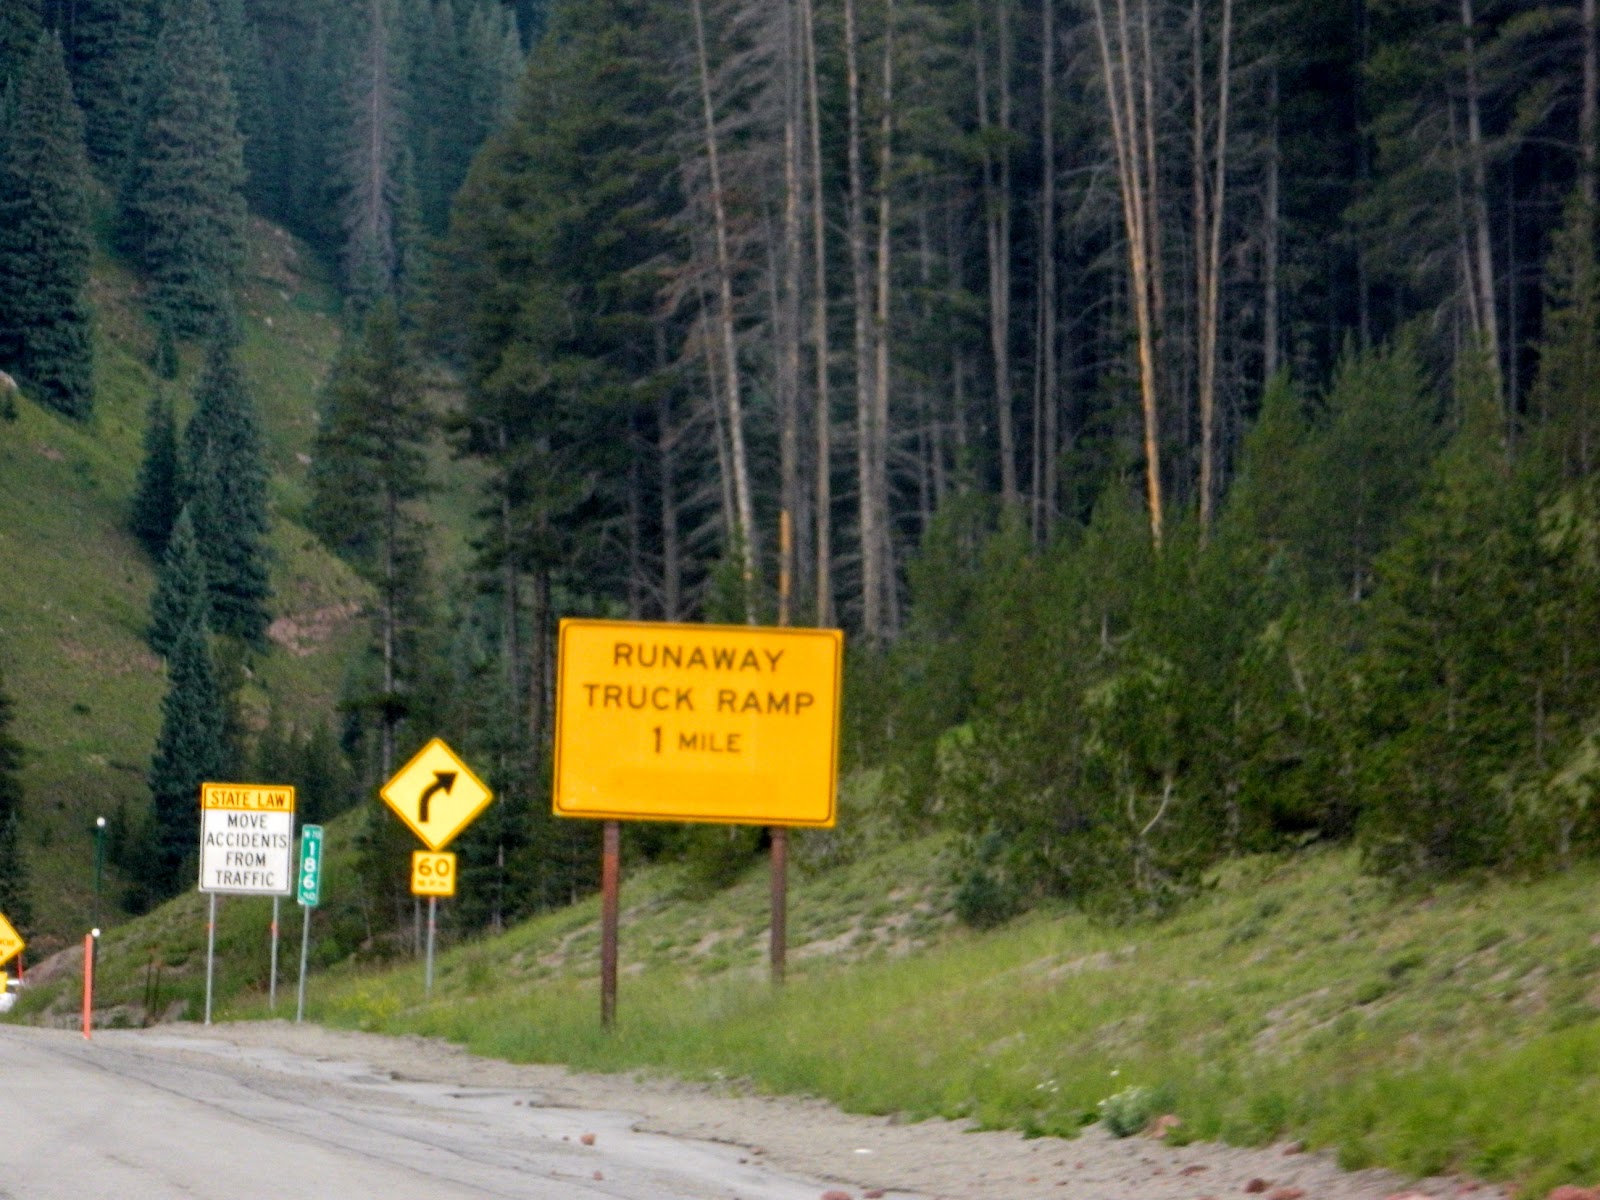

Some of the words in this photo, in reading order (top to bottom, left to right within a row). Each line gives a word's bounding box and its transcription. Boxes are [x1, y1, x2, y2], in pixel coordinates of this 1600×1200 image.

[613, 643, 785, 673] RUNAWAY
[584, 683, 695, 712] TRUCK
[717, 689, 815, 715] RAMP
[652, 726, 662, 753] 1
[678, 732, 742, 754] MILE
[211, 790, 250, 807] STATE
[257, 792, 286, 808] LAW
[227, 813, 268, 829] MOVE
[206, 832, 288, 849] ACCIDENTS
[226, 850, 266, 867] FROM
[418, 857, 450, 877] 60
[215, 870, 275, 887] TRAFFIC
